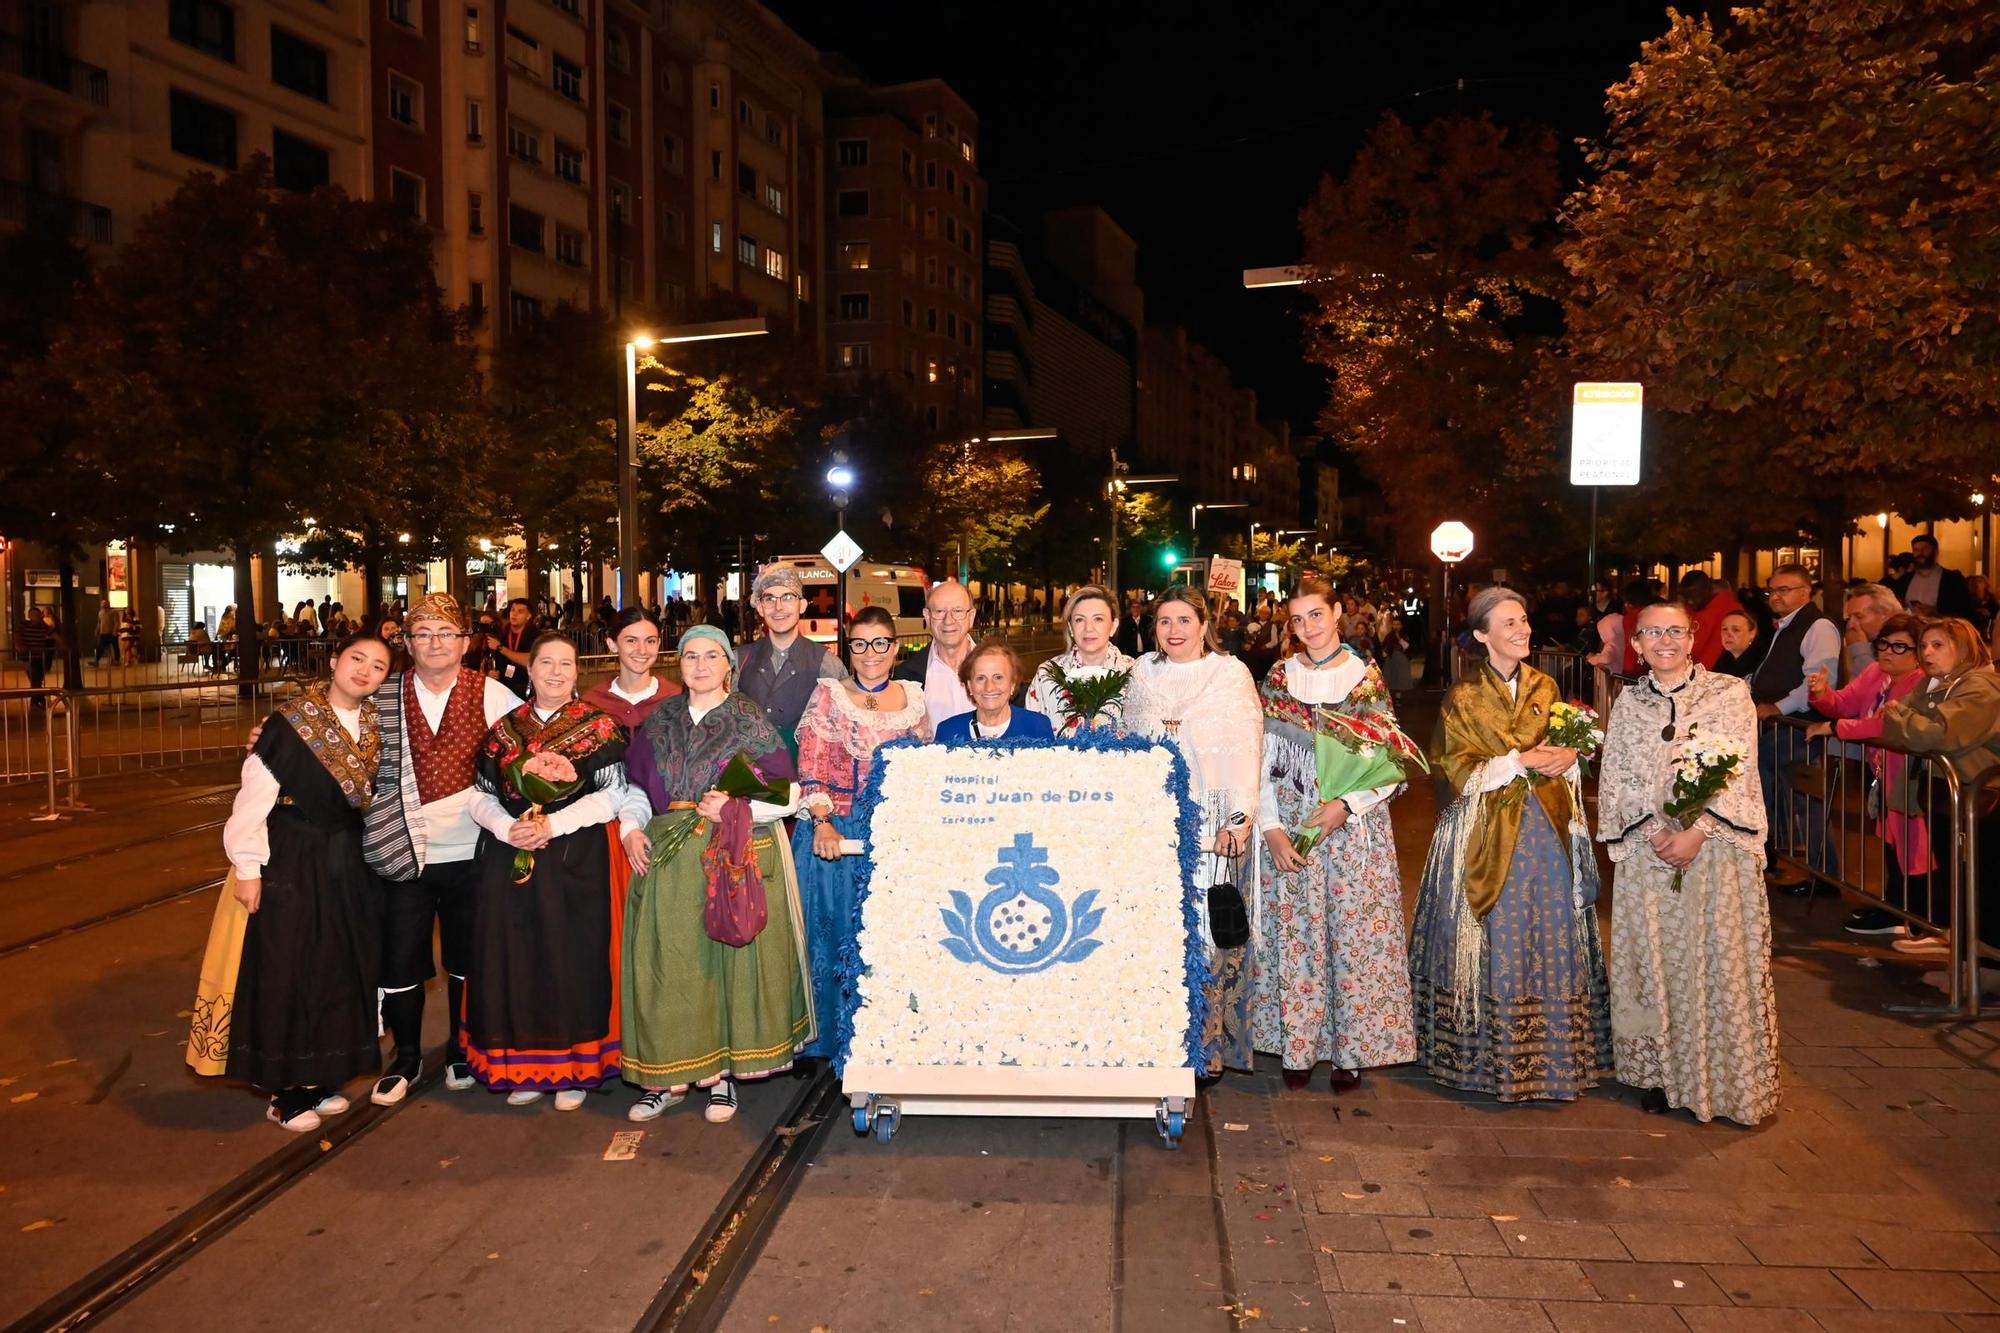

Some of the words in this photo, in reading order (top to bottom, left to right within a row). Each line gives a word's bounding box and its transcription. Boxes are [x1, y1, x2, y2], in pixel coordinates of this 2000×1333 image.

[944, 775, 999, 785] Hospital
[940, 788, 976, 804] San
[986, 790, 1033, 804] Juan
[1041, 790, 1062, 802] de
[1068, 790, 1114, 803] Dios
